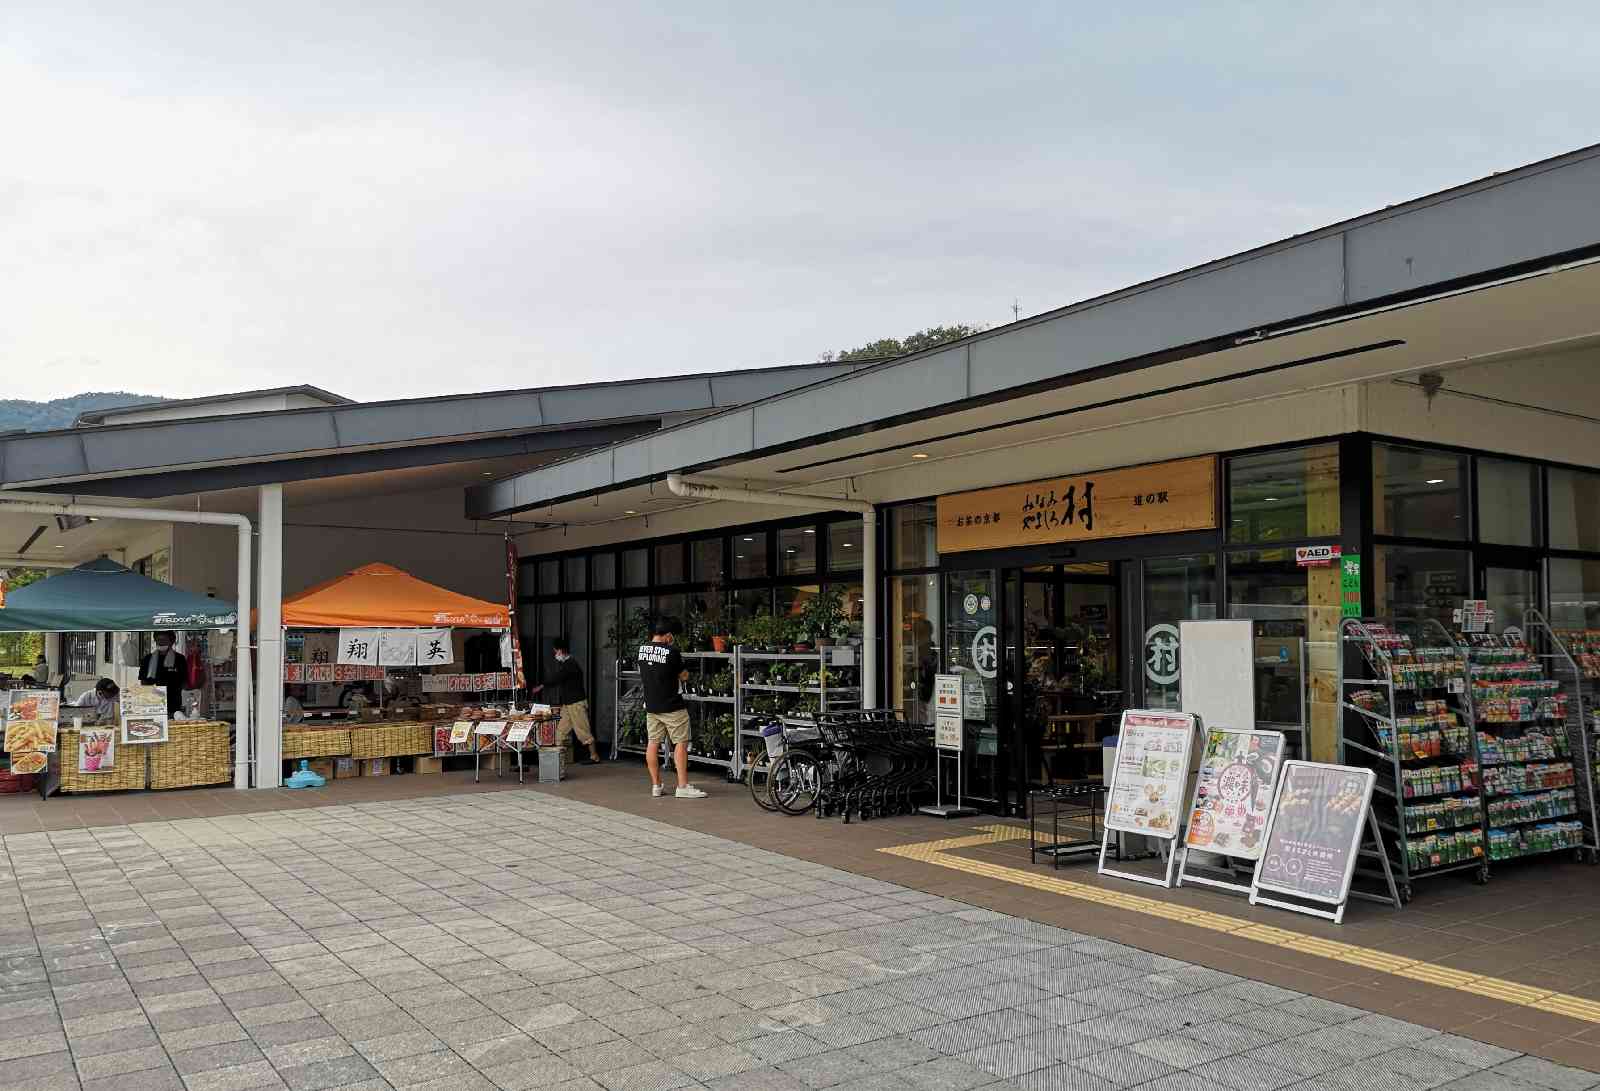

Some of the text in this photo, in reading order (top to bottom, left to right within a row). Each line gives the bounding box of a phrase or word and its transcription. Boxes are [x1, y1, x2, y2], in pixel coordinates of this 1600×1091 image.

[1061, 481, 1094, 530] 村
[1133, 491, 1169, 506] 道の駅
[1307, 548, 1329, 557] AED
[346, 638, 369, 660] 翔
[426, 640, 446, 659] 英
[654, 646, 670, 657] STOP
[1147, 636, 1179, 672] 村
